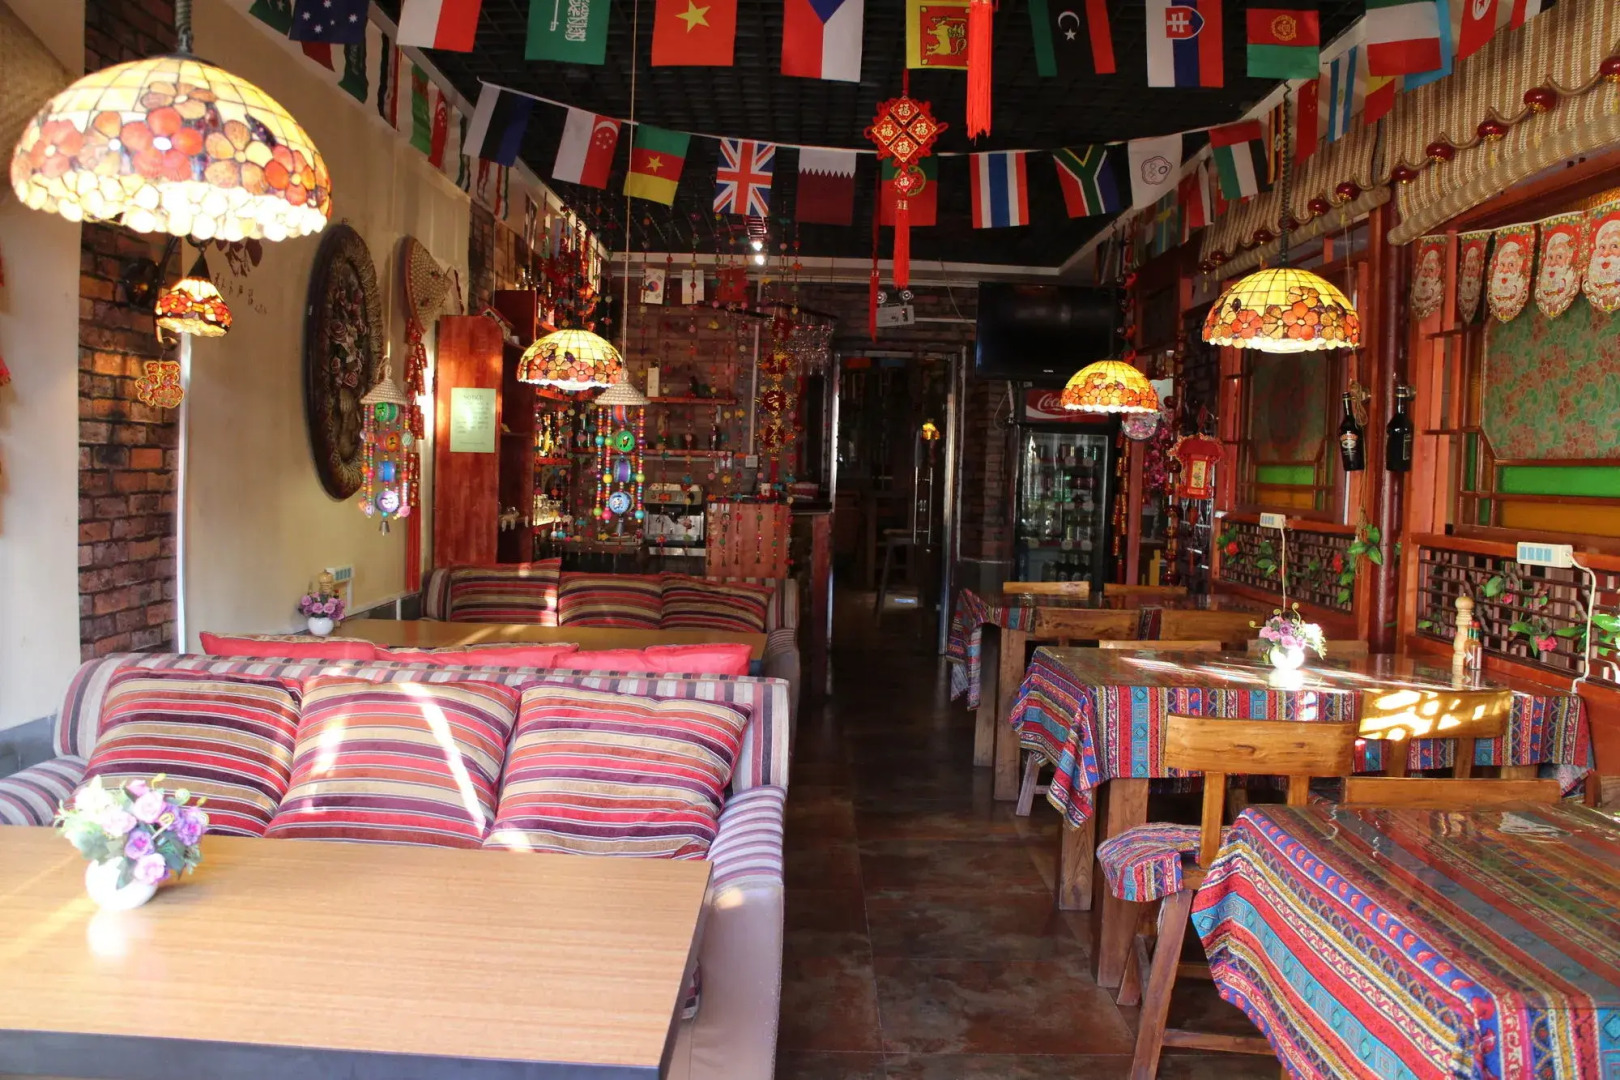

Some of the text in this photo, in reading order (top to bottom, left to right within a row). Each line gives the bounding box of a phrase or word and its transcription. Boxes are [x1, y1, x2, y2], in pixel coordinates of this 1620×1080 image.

[898, 103, 911, 116] 福
[881, 124, 894, 136] 福
[915, 122, 928, 135] 福
[897, 141, 910, 153] 福
